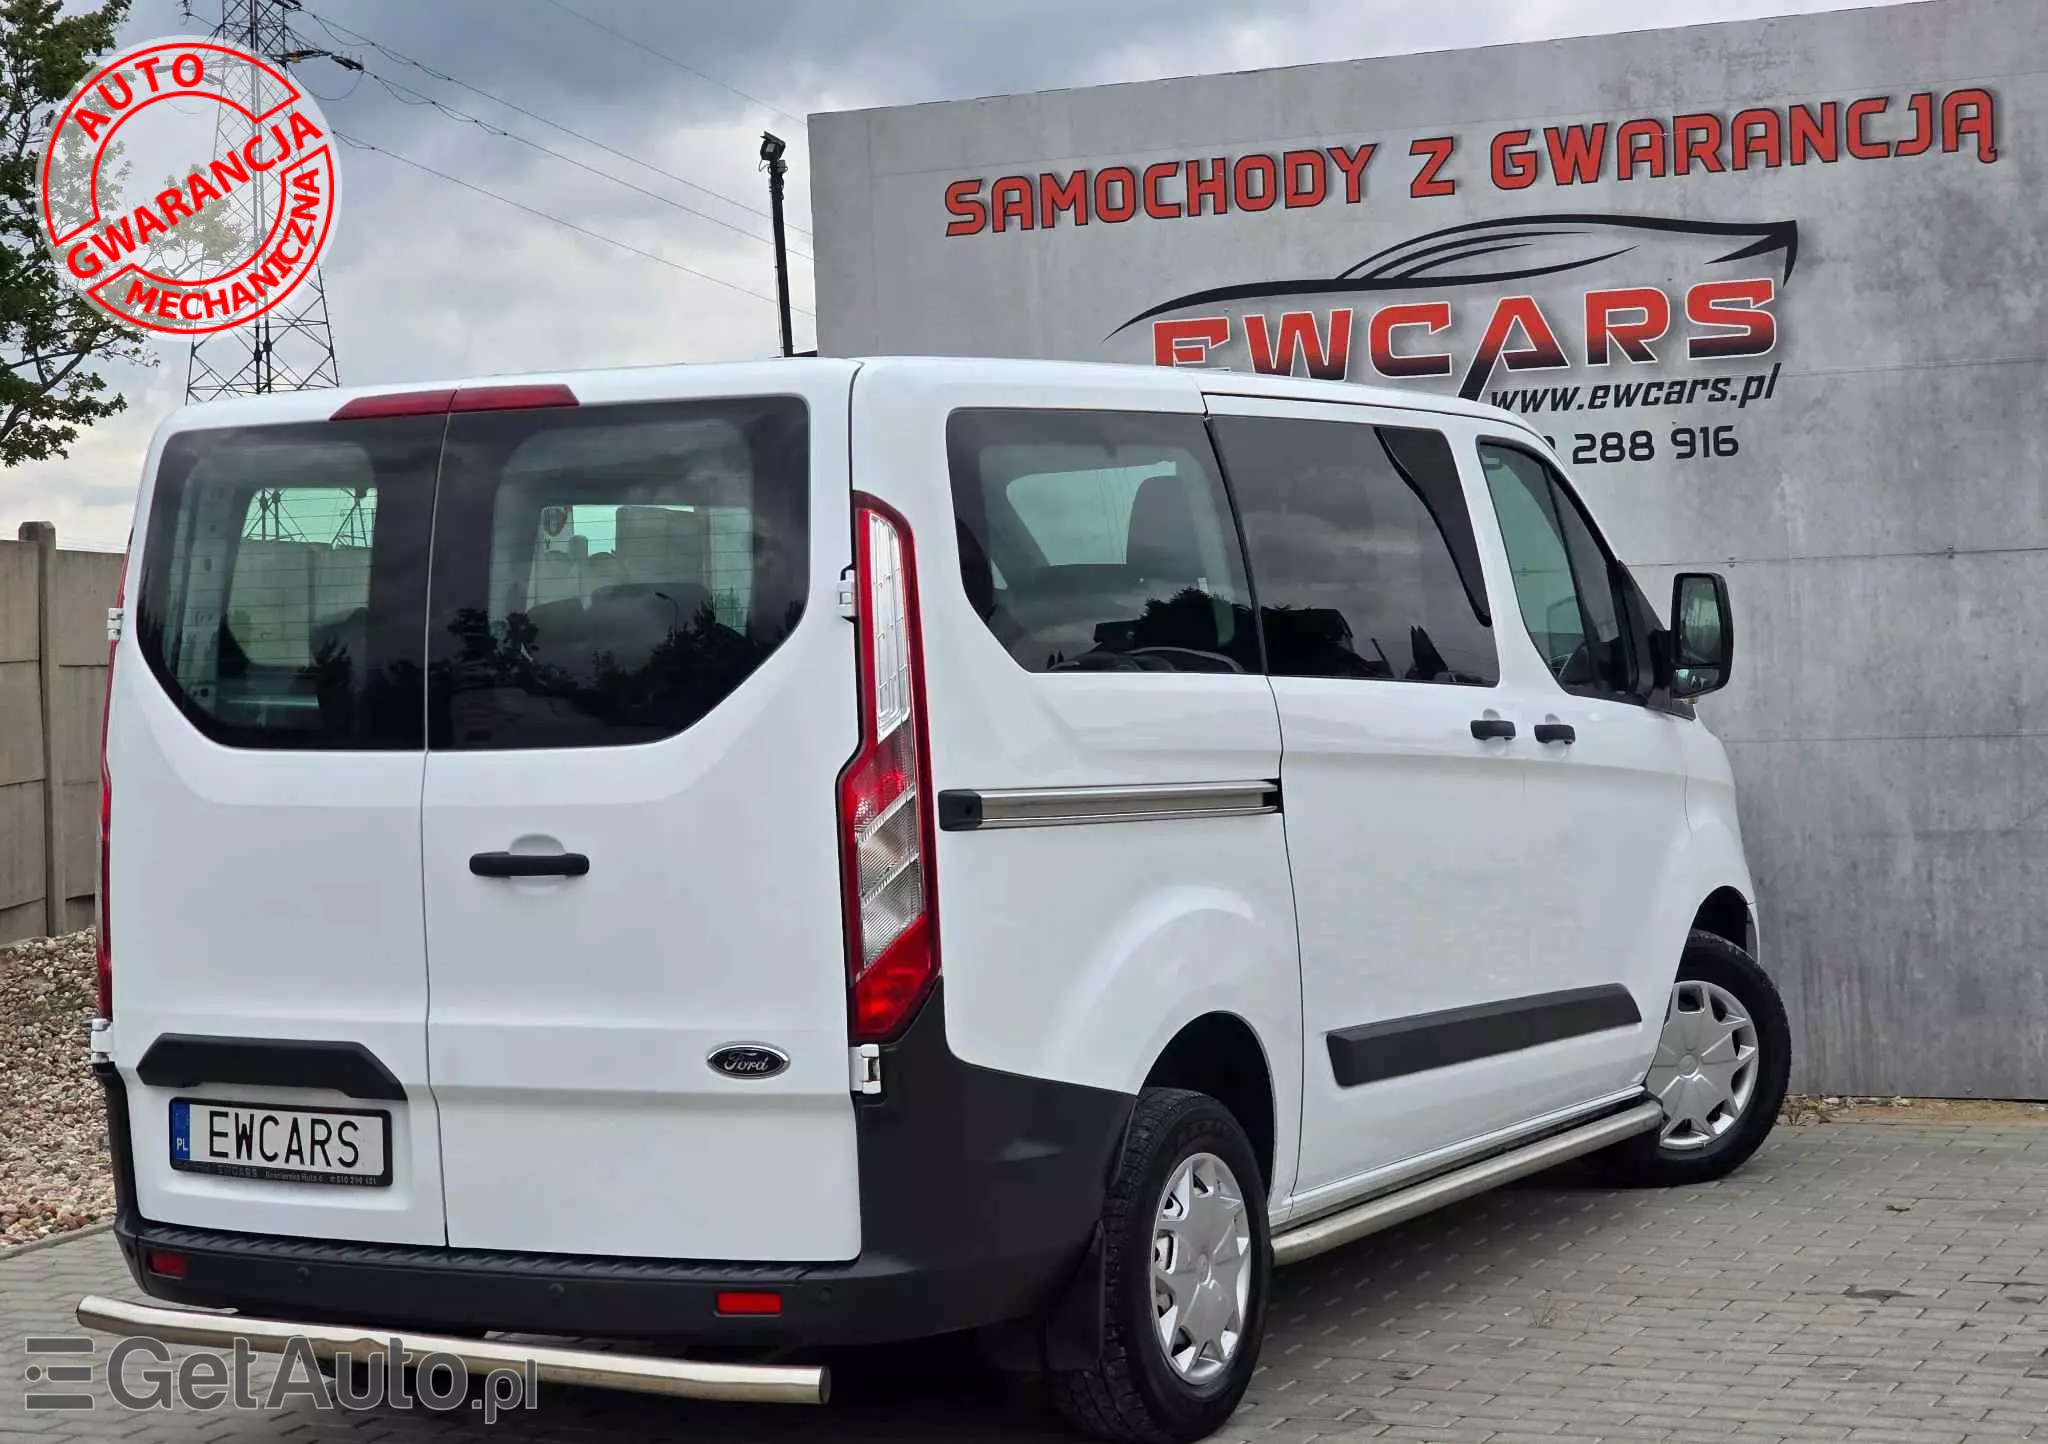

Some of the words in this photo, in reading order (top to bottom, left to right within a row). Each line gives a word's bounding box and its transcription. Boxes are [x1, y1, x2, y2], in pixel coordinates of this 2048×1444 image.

[945, 143, 1378, 237] SAMOCHODY
[1409, 137, 1456, 198] Z
[1491, 88, 1998, 190] GWARANCJĄ
[1152, 279, 1778, 400] EWCARS
[1491, 362, 1782, 415] www.ewcars.pl
[1572, 431, 1656, 465] 288
[1671, 425, 1740, 459] 916
[723, 1051, 768, 1071] Ford
[176, 1138, 189, 1151] PL
[209, 1110, 360, 1169] EWCARS
